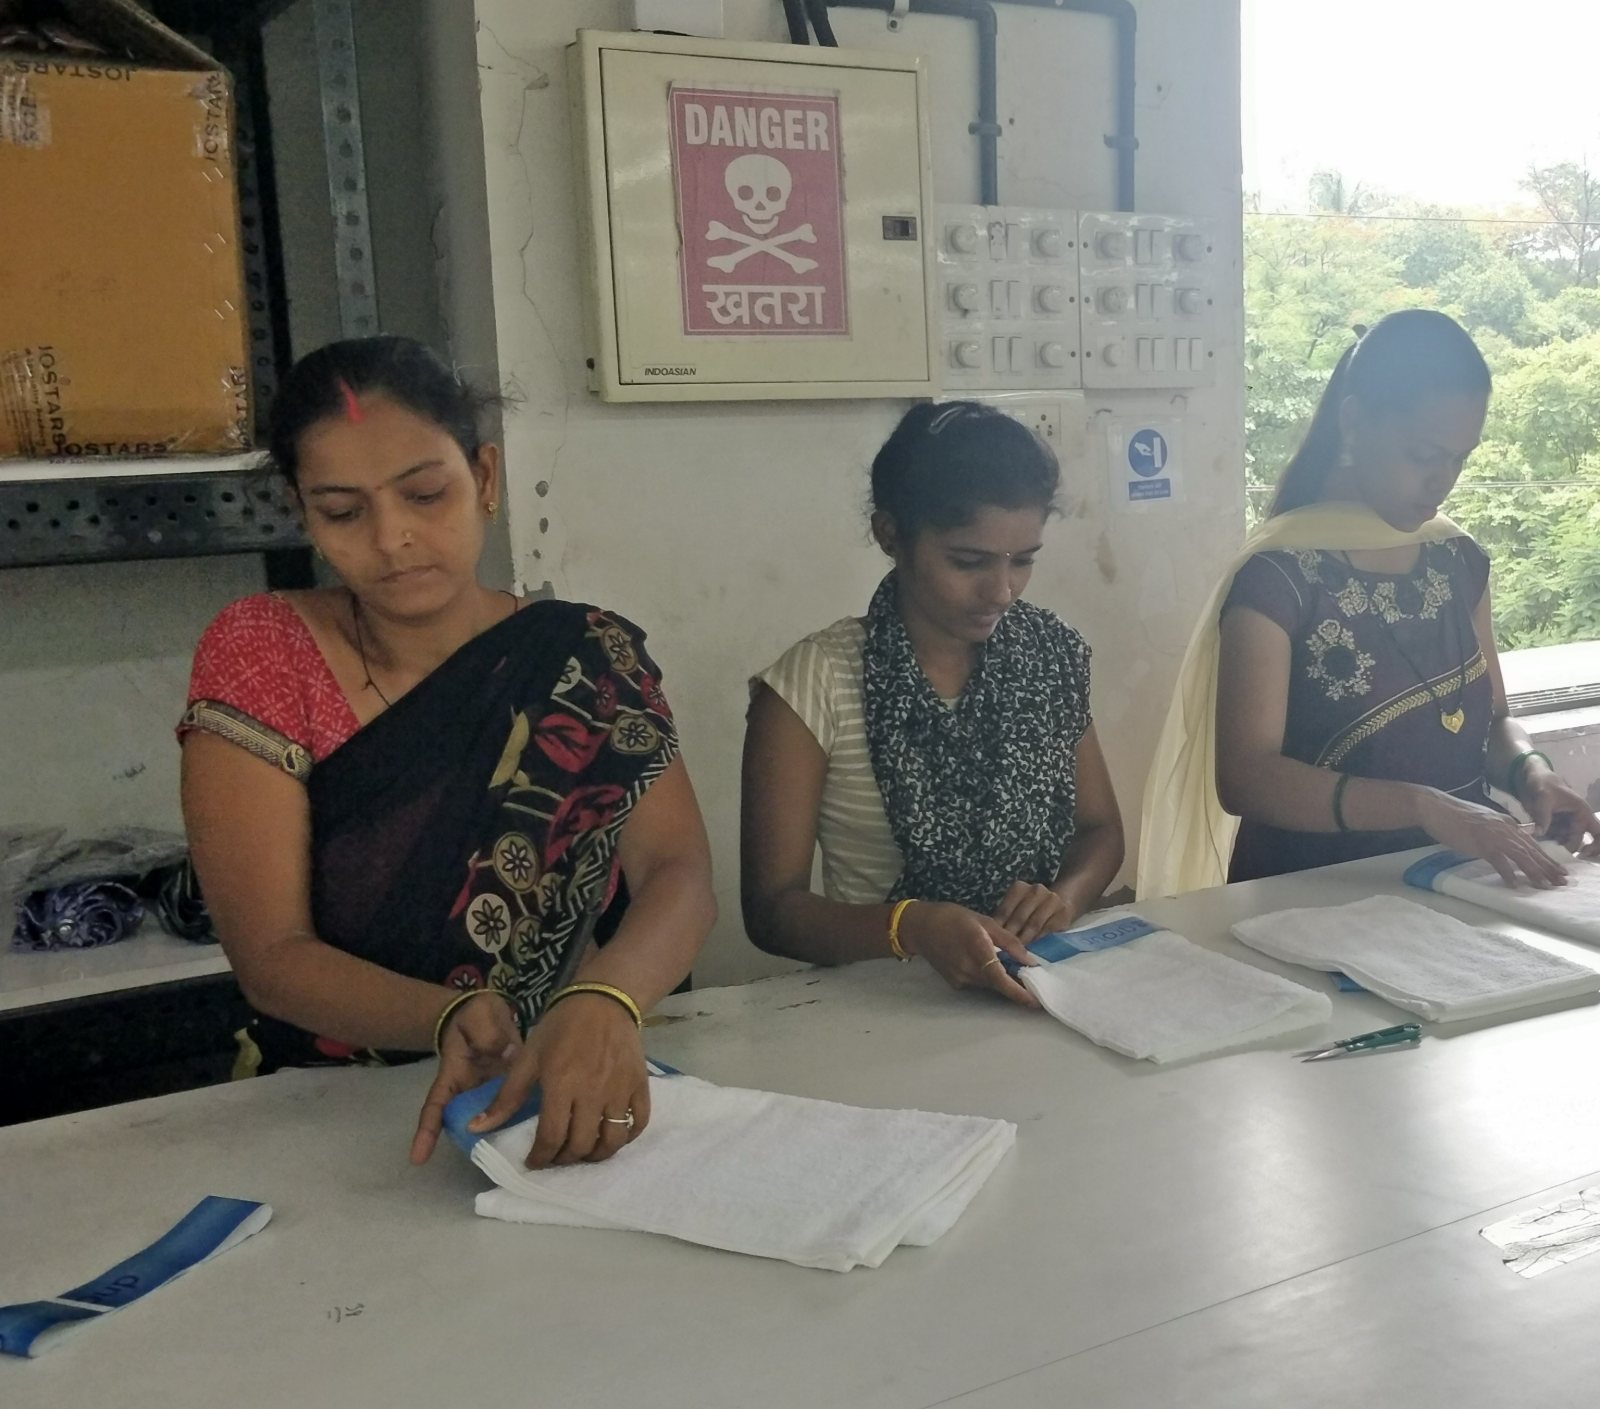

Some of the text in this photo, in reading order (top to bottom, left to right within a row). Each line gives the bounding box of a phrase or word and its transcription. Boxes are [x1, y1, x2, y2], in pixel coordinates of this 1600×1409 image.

[684, 103, 830, 151] DANGER
[702, 284, 826, 326] खतरा
[644, 366, 697, 377] INDOASIAN
